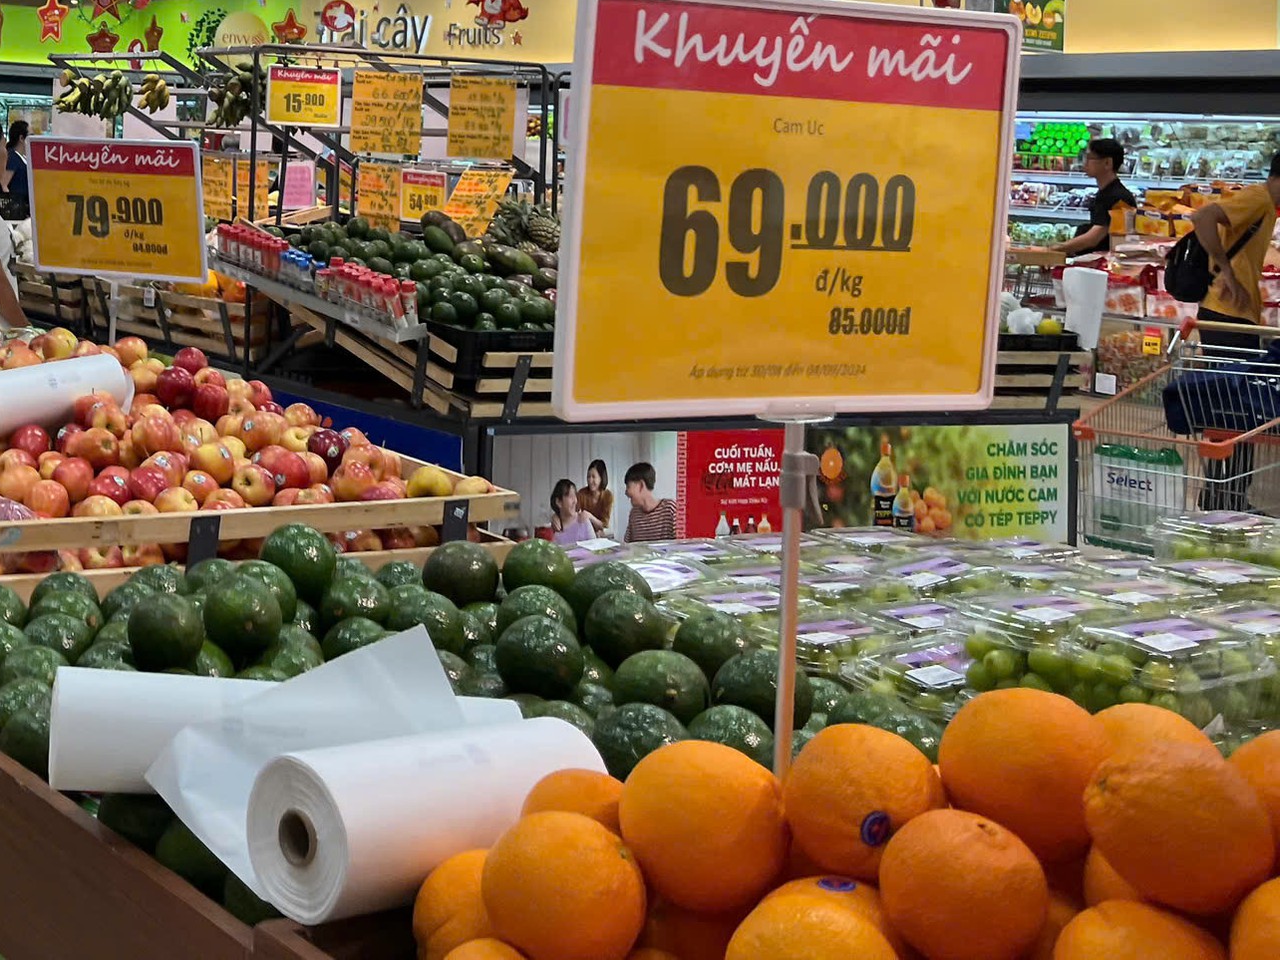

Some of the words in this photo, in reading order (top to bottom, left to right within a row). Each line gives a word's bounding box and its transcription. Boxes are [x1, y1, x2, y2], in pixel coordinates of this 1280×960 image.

[376, 3, 431, 54] cây
[448, 23, 501, 46] Fruits
[634, 9, 854, 87] Khuyến
[867, 35, 972, 85] mãi
[283, 93, 325, 113] 15.900
[773, 117, 803, 134] Cam
[43, 143, 130, 171] Khuyến
[134, 148, 181, 169] mãi
[66, 193, 164, 240] 79.900
[658, 164, 917, 298] 69.000
[815, 266, 864, 299] đ/kg
[828, 306, 912, 336] 85.000đ
[714, 443, 741, 459] CUỐI
[986, 439, 1028, 457] CHĂM
[1030, 437, 1058, 456] SÓC
[708, 461, 734, 474] CƠM
[736, 461, 754, 476] MẸ
[965, 466, 989, 480] GIA
[992, 461, 1027, 480] ĐÌNH
[1030, 464, 1058, 482] BẠN
[733, 473, 757, 488] MÁT
[758, 476, 780, 489] LẠN
[1106, 471, 1153, 492] Select
[984, 484, 1025, 504] NƯỚC
[1027, 487, 1058, 502] CAM
[964, 508, 985, 528] CÓ
[988, 507, 1013, 527] TÉP
[1016, 509, 1058, 526] TEPPY
